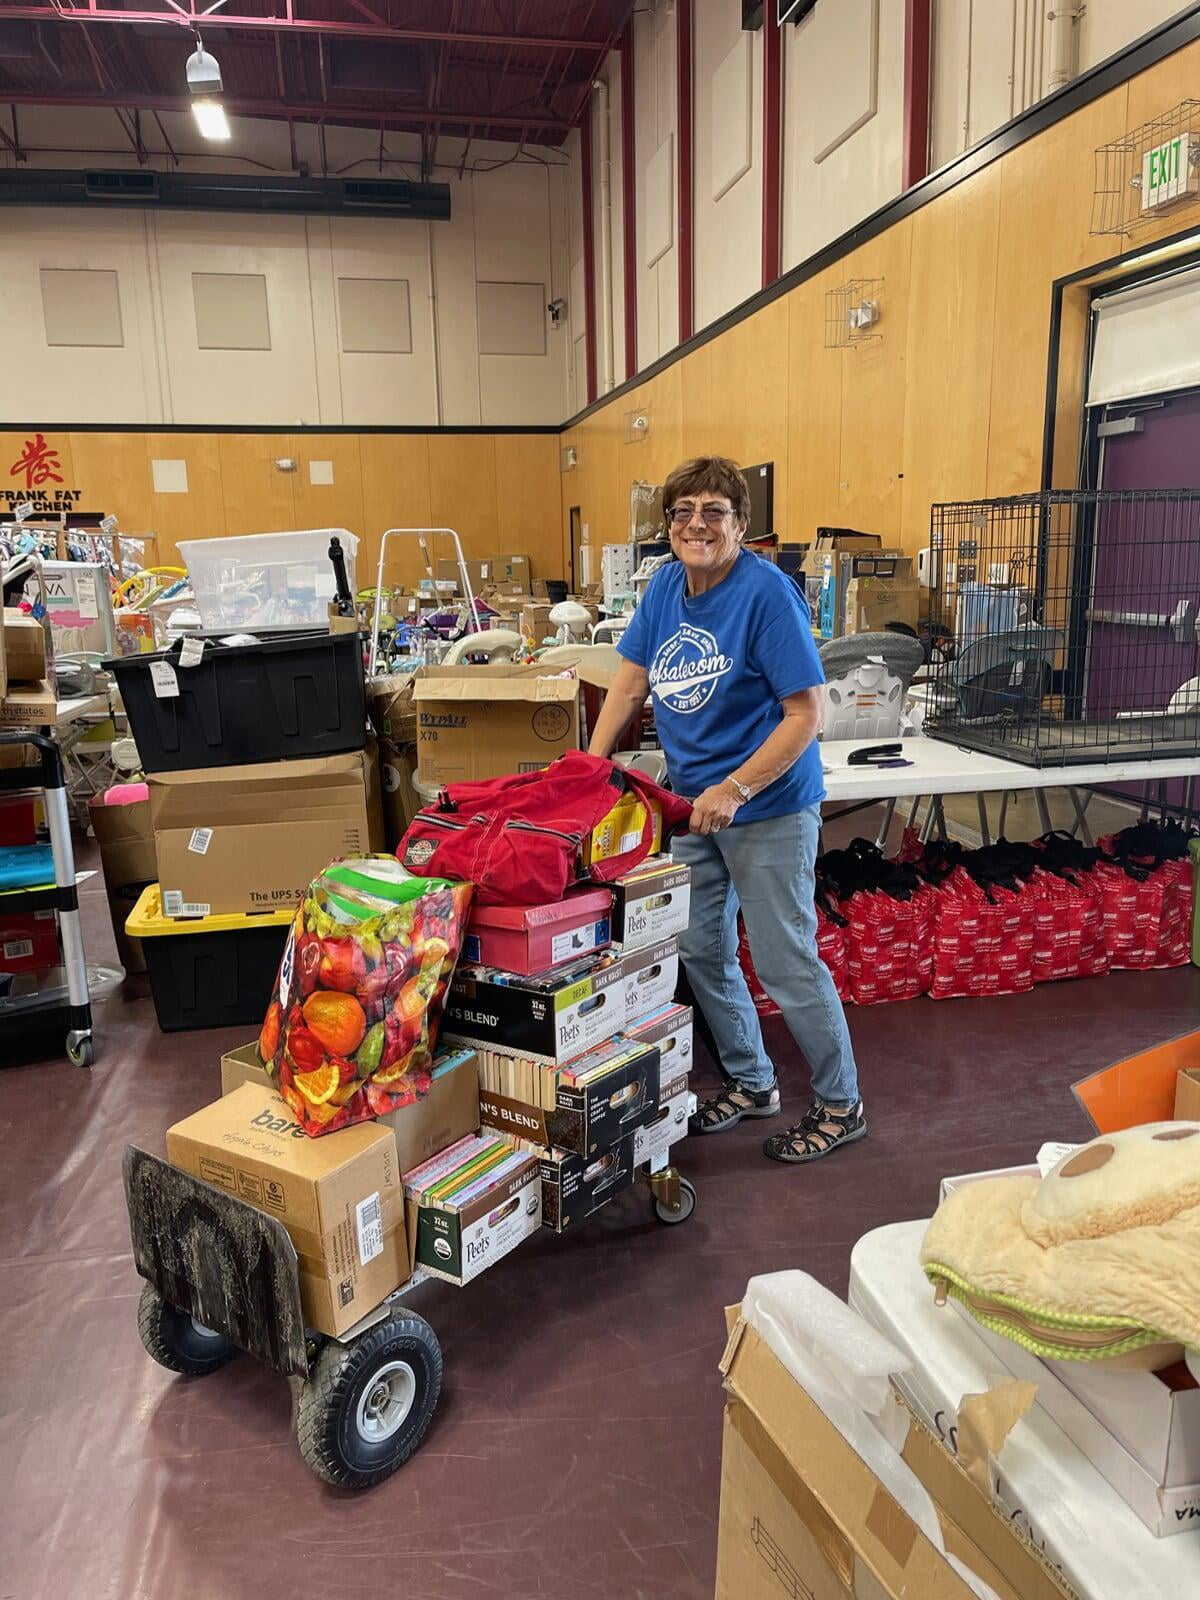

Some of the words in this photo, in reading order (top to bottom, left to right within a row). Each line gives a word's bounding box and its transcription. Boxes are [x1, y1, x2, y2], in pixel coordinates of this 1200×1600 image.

[1150, 141, 1181, 190] EXIT
[0, 490, 48, 501] FRANK
[55, 490, 81, 501] FAT
[9, 502, 72, 511] KCHEN
[420, 731, 438, 741] X70
[250, 892, 268, 901] The
[271, 889, 292, 899] UPS
[572, 984, 588, 1000] DECAF
[595, 975, 608, 989] DARK
[608, 967, 622, 984] ROAST
[464, 1010, 497, 1027] BLEND
[560, 1023, 580, 1045] Peet's
[250, 1109, 305, 1139] bare
[501, 1108, 539, 1130] BLEND
[508, 1177, 522, 1194] DARK
[522, 1166, 538, 1184] ROAST
[434, 1216, 441, 1225] 32
[466, 1236, 490, 1263] Peet's
